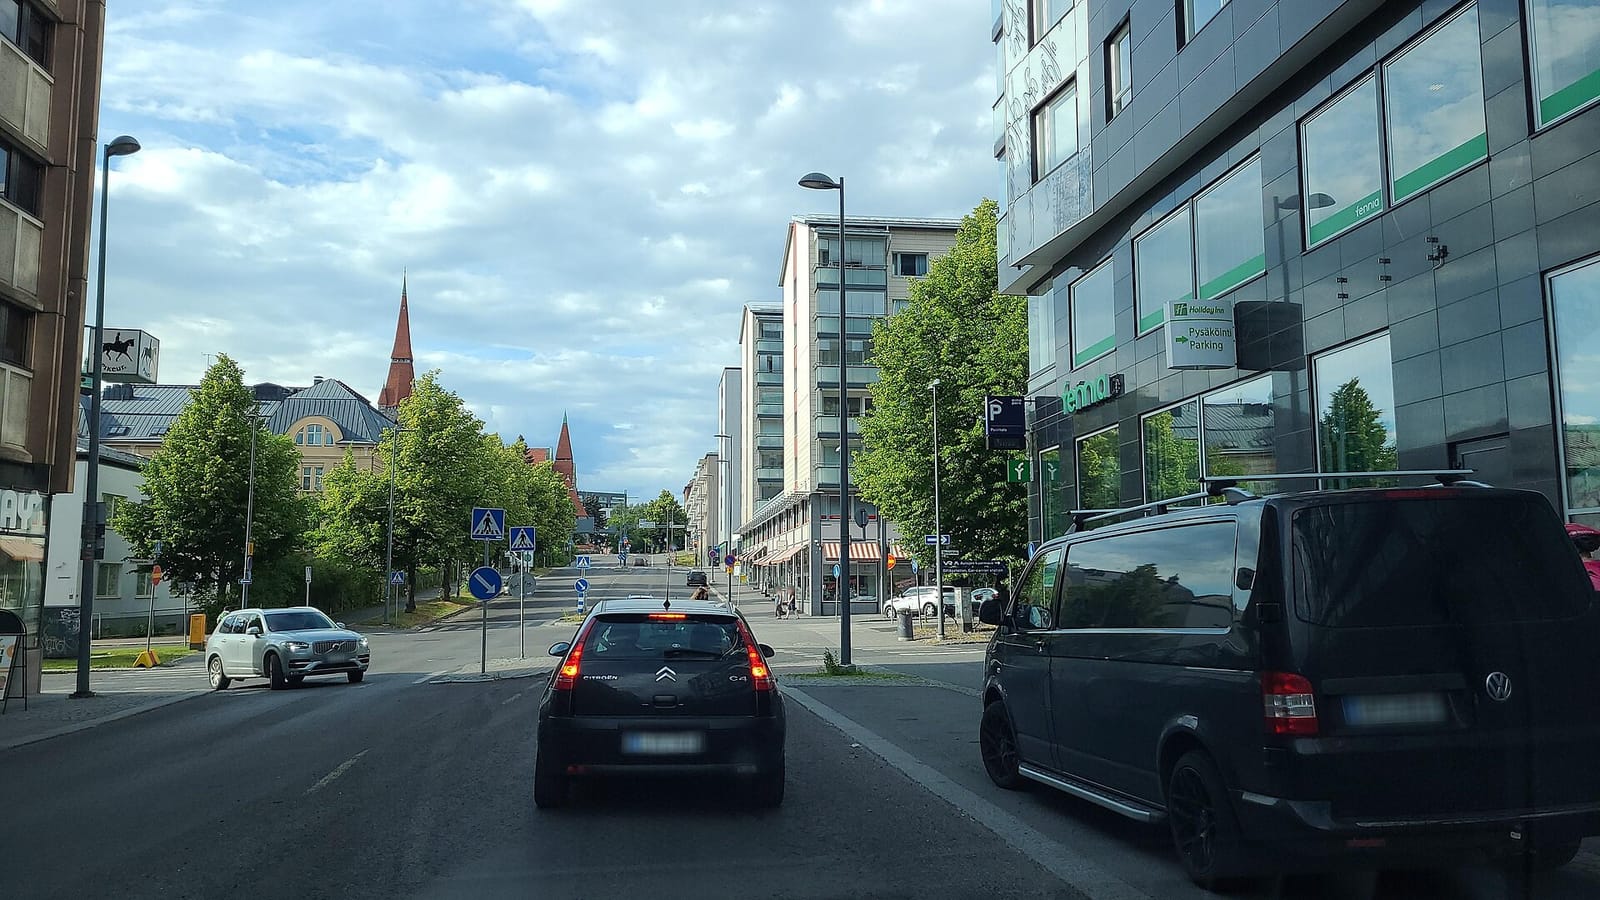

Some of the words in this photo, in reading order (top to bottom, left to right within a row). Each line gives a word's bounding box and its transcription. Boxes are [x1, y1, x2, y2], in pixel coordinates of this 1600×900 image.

[1189, 305, 1214, 315] Holiday
[1215, 305, 1225, 314] Inn
[1189, 327, 1232, 338] Pysäköinti
[1190, 340, 1224, 351] Parking
[1061, 374, 1109, 415] fennia
